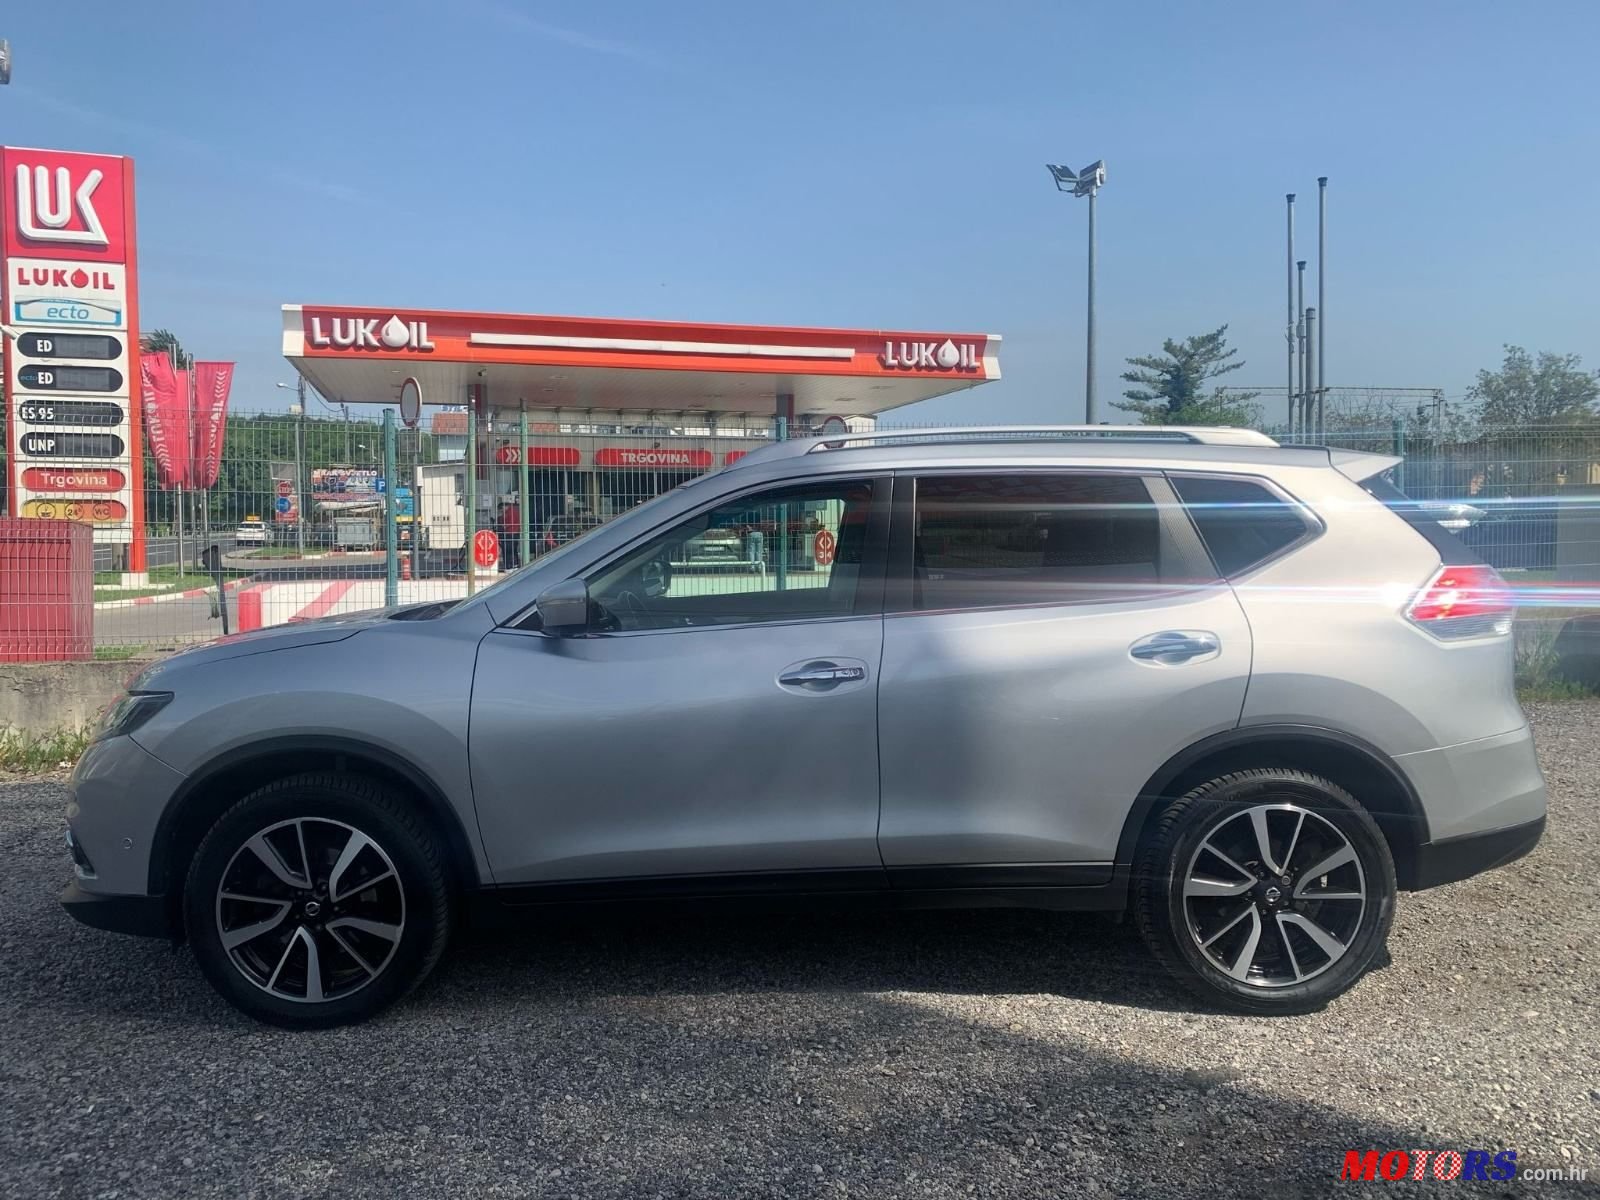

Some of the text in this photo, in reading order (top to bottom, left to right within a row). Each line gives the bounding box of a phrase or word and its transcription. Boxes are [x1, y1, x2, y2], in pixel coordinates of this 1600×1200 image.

[17, 267, 115, 290] LUKOIL
[47, 306, 89, 320] ecto
[311, 314, 435, 349] LUKOIL
[36, 340, 53, 353] ED
[885, 338, 980, 368] LUKOIL
[37, 371, 54, 385] ED
[21, 406, 54, 420] ES 95
[28, 439, 55, 452] UNP
[620, 452, 690, 465] TRGOVINA
[40, 472, 108, 487] Trgovina
[94, 508, 109, 517] WC
[487, 553, 494, 562] 2
